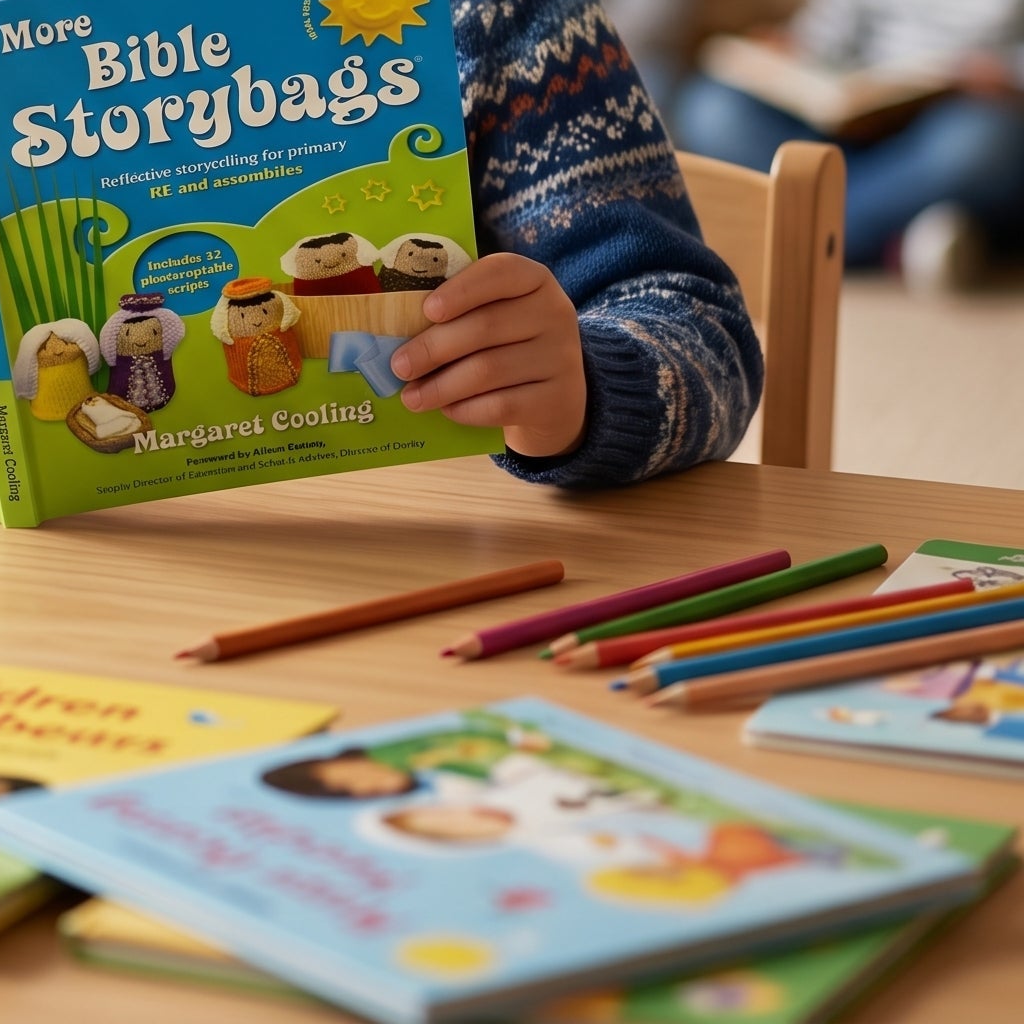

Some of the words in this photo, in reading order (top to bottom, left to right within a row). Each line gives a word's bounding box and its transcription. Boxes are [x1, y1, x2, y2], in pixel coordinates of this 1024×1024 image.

[80, 23, 231, 91] Bible
[11, 55, 420, 168] Storybags
[262, 147, 283, 162] for
[287, 140, 347, 160] primary
[149, 185, 173, 199] RE
[178, 177, 208, 194] and
[206, 250, 222, 261] 32
[132, 414, 265, 454] Margaret
[272, 400, 375, 431] Cooling
[133, 476, 173, 488] Director
[176, 471, 186, 481] of
[380, 442, 391, 451] of
[238, 449, 251, 459] by
[5, 458, 21, 502] Cooling
